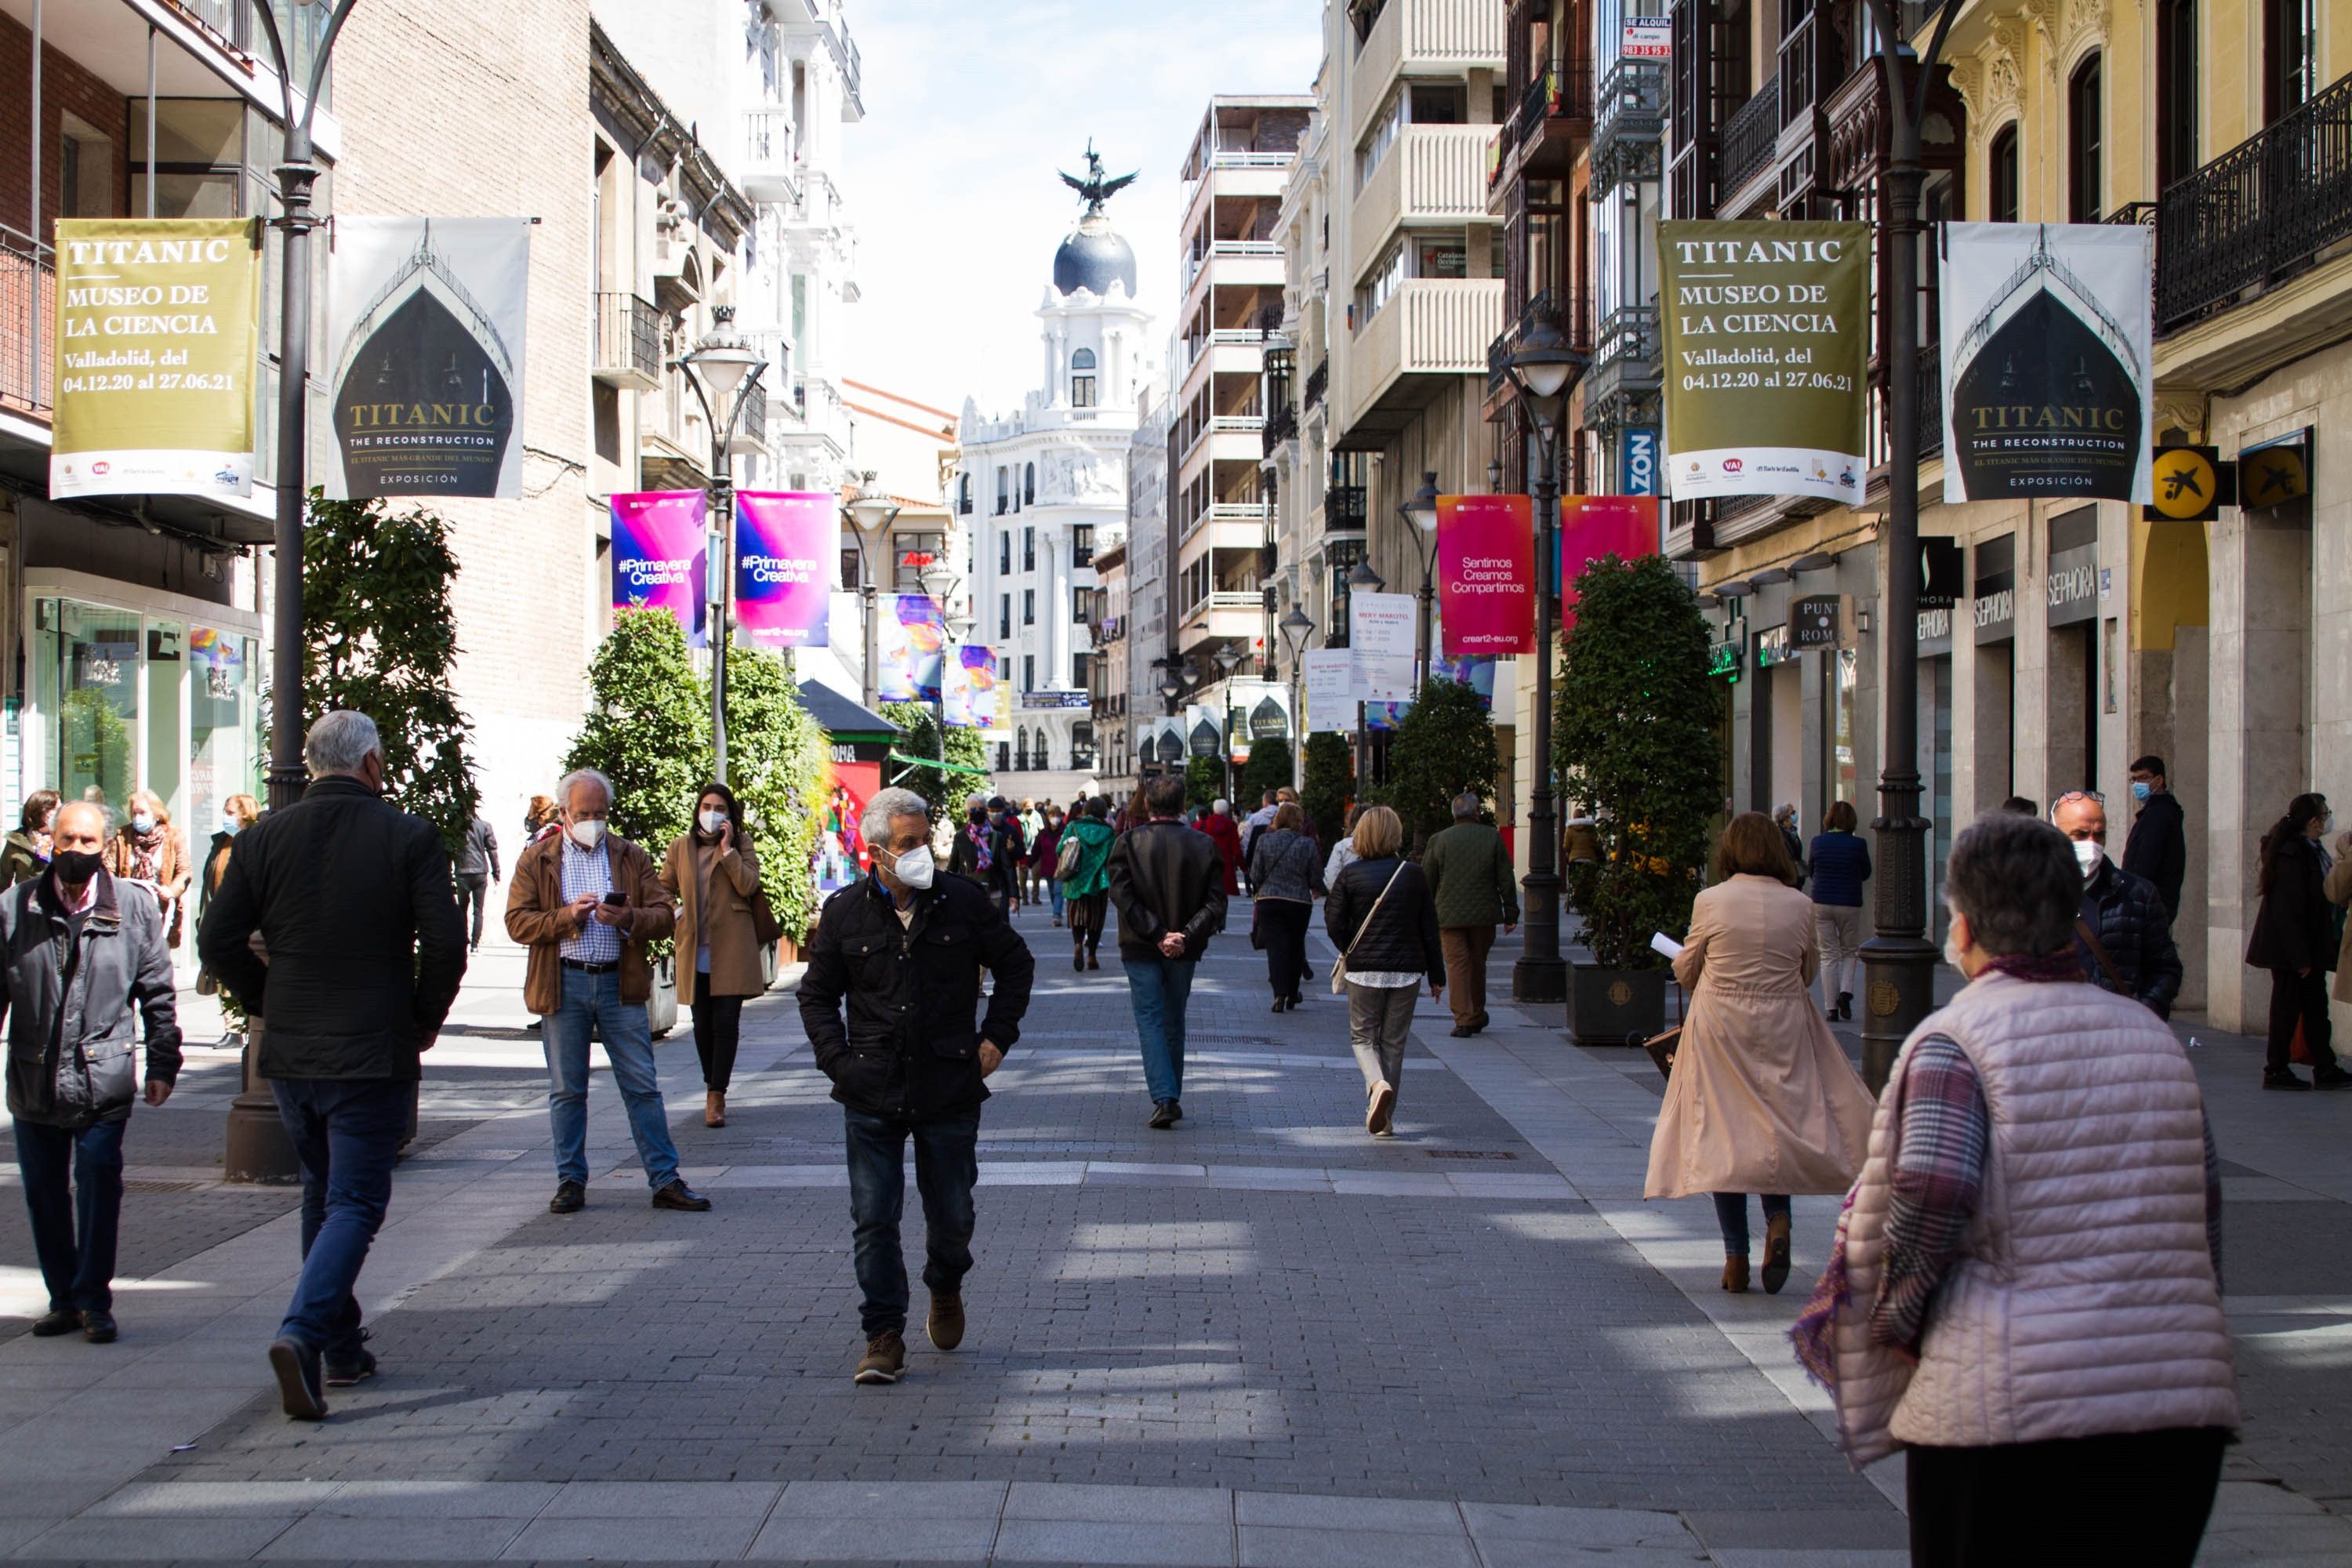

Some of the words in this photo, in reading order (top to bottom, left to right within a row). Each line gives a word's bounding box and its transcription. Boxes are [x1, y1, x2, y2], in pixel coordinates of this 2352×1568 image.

[1639, 19, 1671, 27] ALQUIL
[1624, 45, 1637, 55] 983
[1640, 45, 1650, 55] 35
[1651, 46, 1661, 56] 95
[68, 240, 229, 265] TITANIC
[1676, 241, 1842, 263] TITANIC
[66, 286, 163, 307] MUSEO
[169, 285, 209, 305] DE
[1679, 285, 1780, 306] MUSEO
[1787, 285, 1828, 303] DE
[65, 318, 99, 337] LA
[103, 314, 218, 335] CIENCIA
[1680, 315, 1718, 336] LA
[1722, 314, 1838, 333] CIENCIA
[64, 350, 155, 368] Valladolid,
[160, 349, 188, 365] del
[1681, 347, 1779, 366] Valladolid,
[1784, 347, 1812, 364] del
[64, 375, 133, 393] 04.12.20
[137, 374, 154, 390] al
[159, 374, 233, 390] 27.06.21
[1682, 372, 1759, 391] 04.12.20
[1764, 372, 1780, 387] al
[1785, 372, 1852, 391] 27.06.21
[350, 404, 495, 426] TITANIC
[1972, 405, 2124, 430] TITANIC
[350, 437, 370, 447] THE
[376, 436, 494, 445] RECONSTRUCTION
[1972, 440, 1997, 449] THE
[2005, 438, 2125, 450] RECONSTRUCTION
[360, 455, 390, 463] TITANIC
[463, 456, 494, 464] MUNDO
[1986, 457, 2020, 466] TITANIC
[380, 474, 458, 484] EXPOSICIÓN
[2009, 476, 2092, 486] EXPOSICIÓN
[618, 558, 691, 574] #Primavera
[742, 555, 817, 572] #Primavera
[1462, 557, 1512, 569] Sentimos
[630, 571, 684, 586] Creativa
[753, 568, 809, 583] Creativa
[1463, 570, 1512, 581] Creamos
[1451, 582, 1525, 595] Compartimos
[2048, 564, 2096, 607] SEPHORA
[1804, 602, 1842, 615] PUNT
[1974, 589, 2014, 628] SEPHORA
[1462, 634, 1519, 644] creart2-eu.org
